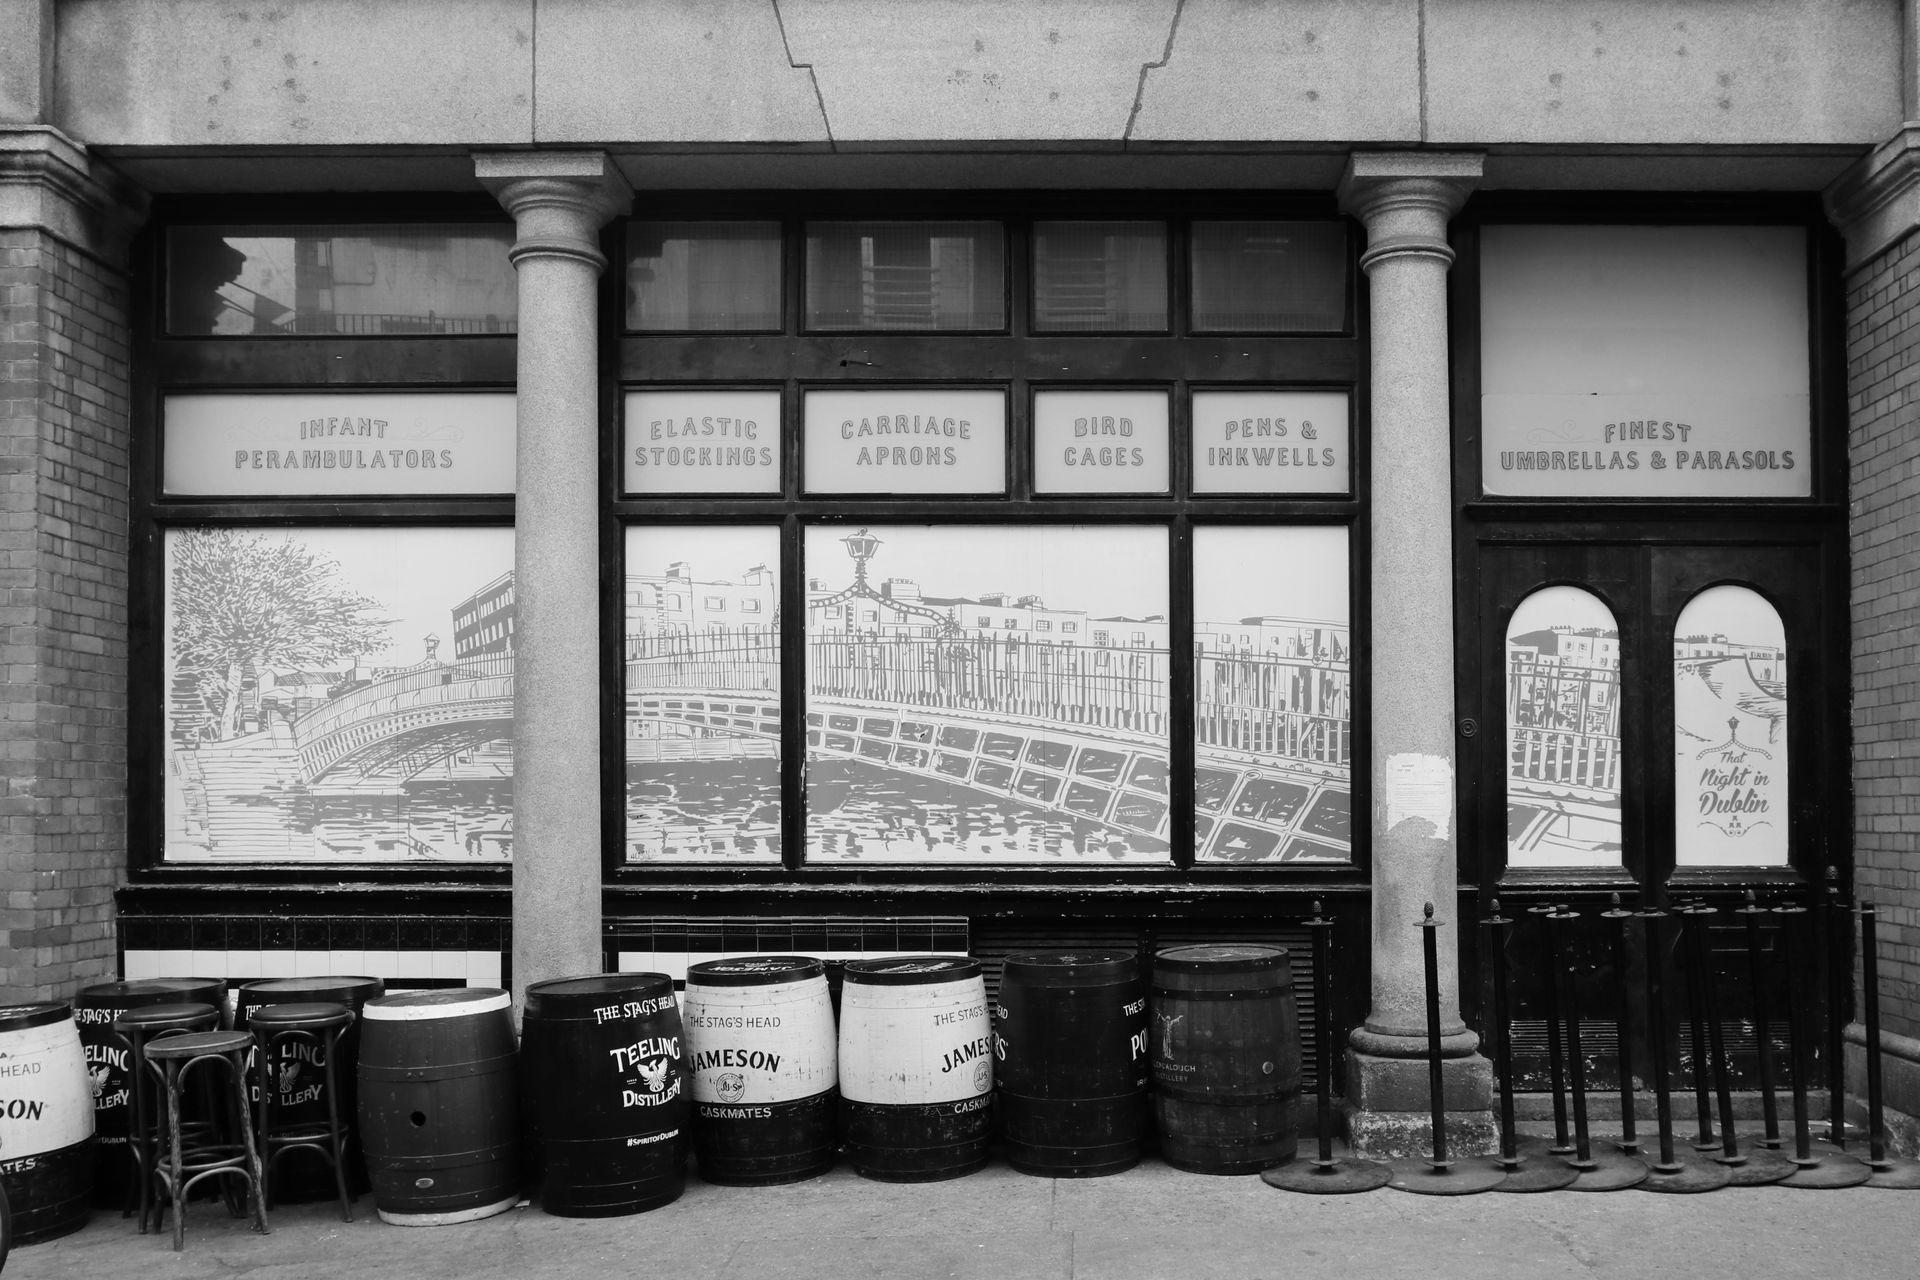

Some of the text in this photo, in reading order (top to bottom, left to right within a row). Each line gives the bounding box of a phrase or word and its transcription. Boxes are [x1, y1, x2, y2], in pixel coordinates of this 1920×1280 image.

[300, 417, 389, 440] INFANT
[650, 416, 757, 440] ELASTIC
[841, 414, 971, 440] CARRIAGE
[1074, 416, 1134, 438] BIRD
[1225, 417, 1317, 440] PENS &
[1605, 420, 1692, 443] FINEST
[235, 450, 453, 469] PERAMBULATORS
[635, 447, 772, 466] STOCKINGS
[857, 446, 957, 466] APRONS
[1064, 447, 1144, 466] CAGES
[1208, 447, 1336, 467] INKWELLS
[1500, 450, 1795, 471] UMBRELLAS & PARASOLS
[1720, 750, 1748, 763] That
[1699, 766, 1770, 791] Night in
[1699, 788, 1769, 816] Dublin
[82, 1008, 111, 1024] STAG'S
[594, 995, 675, 1025] THE STAG'S HEAD
[934, 1011, 956, 1026] THE
[958, 1005, 984, 1021] STAG'S
[1123, 1001, 1138, 1017] THE
[690, 1016, 781, 1028] THE STAG'S HEAD
[610, 1037, 681, 1073] TEELING
[690, 1049, 781, 1075] JAMESON
[1, 1062, 41, 1078] HEAD
[622, 1077, 682, 1108] DISTILLERY
[701, 1106, 772, 1119] CASKMATES
